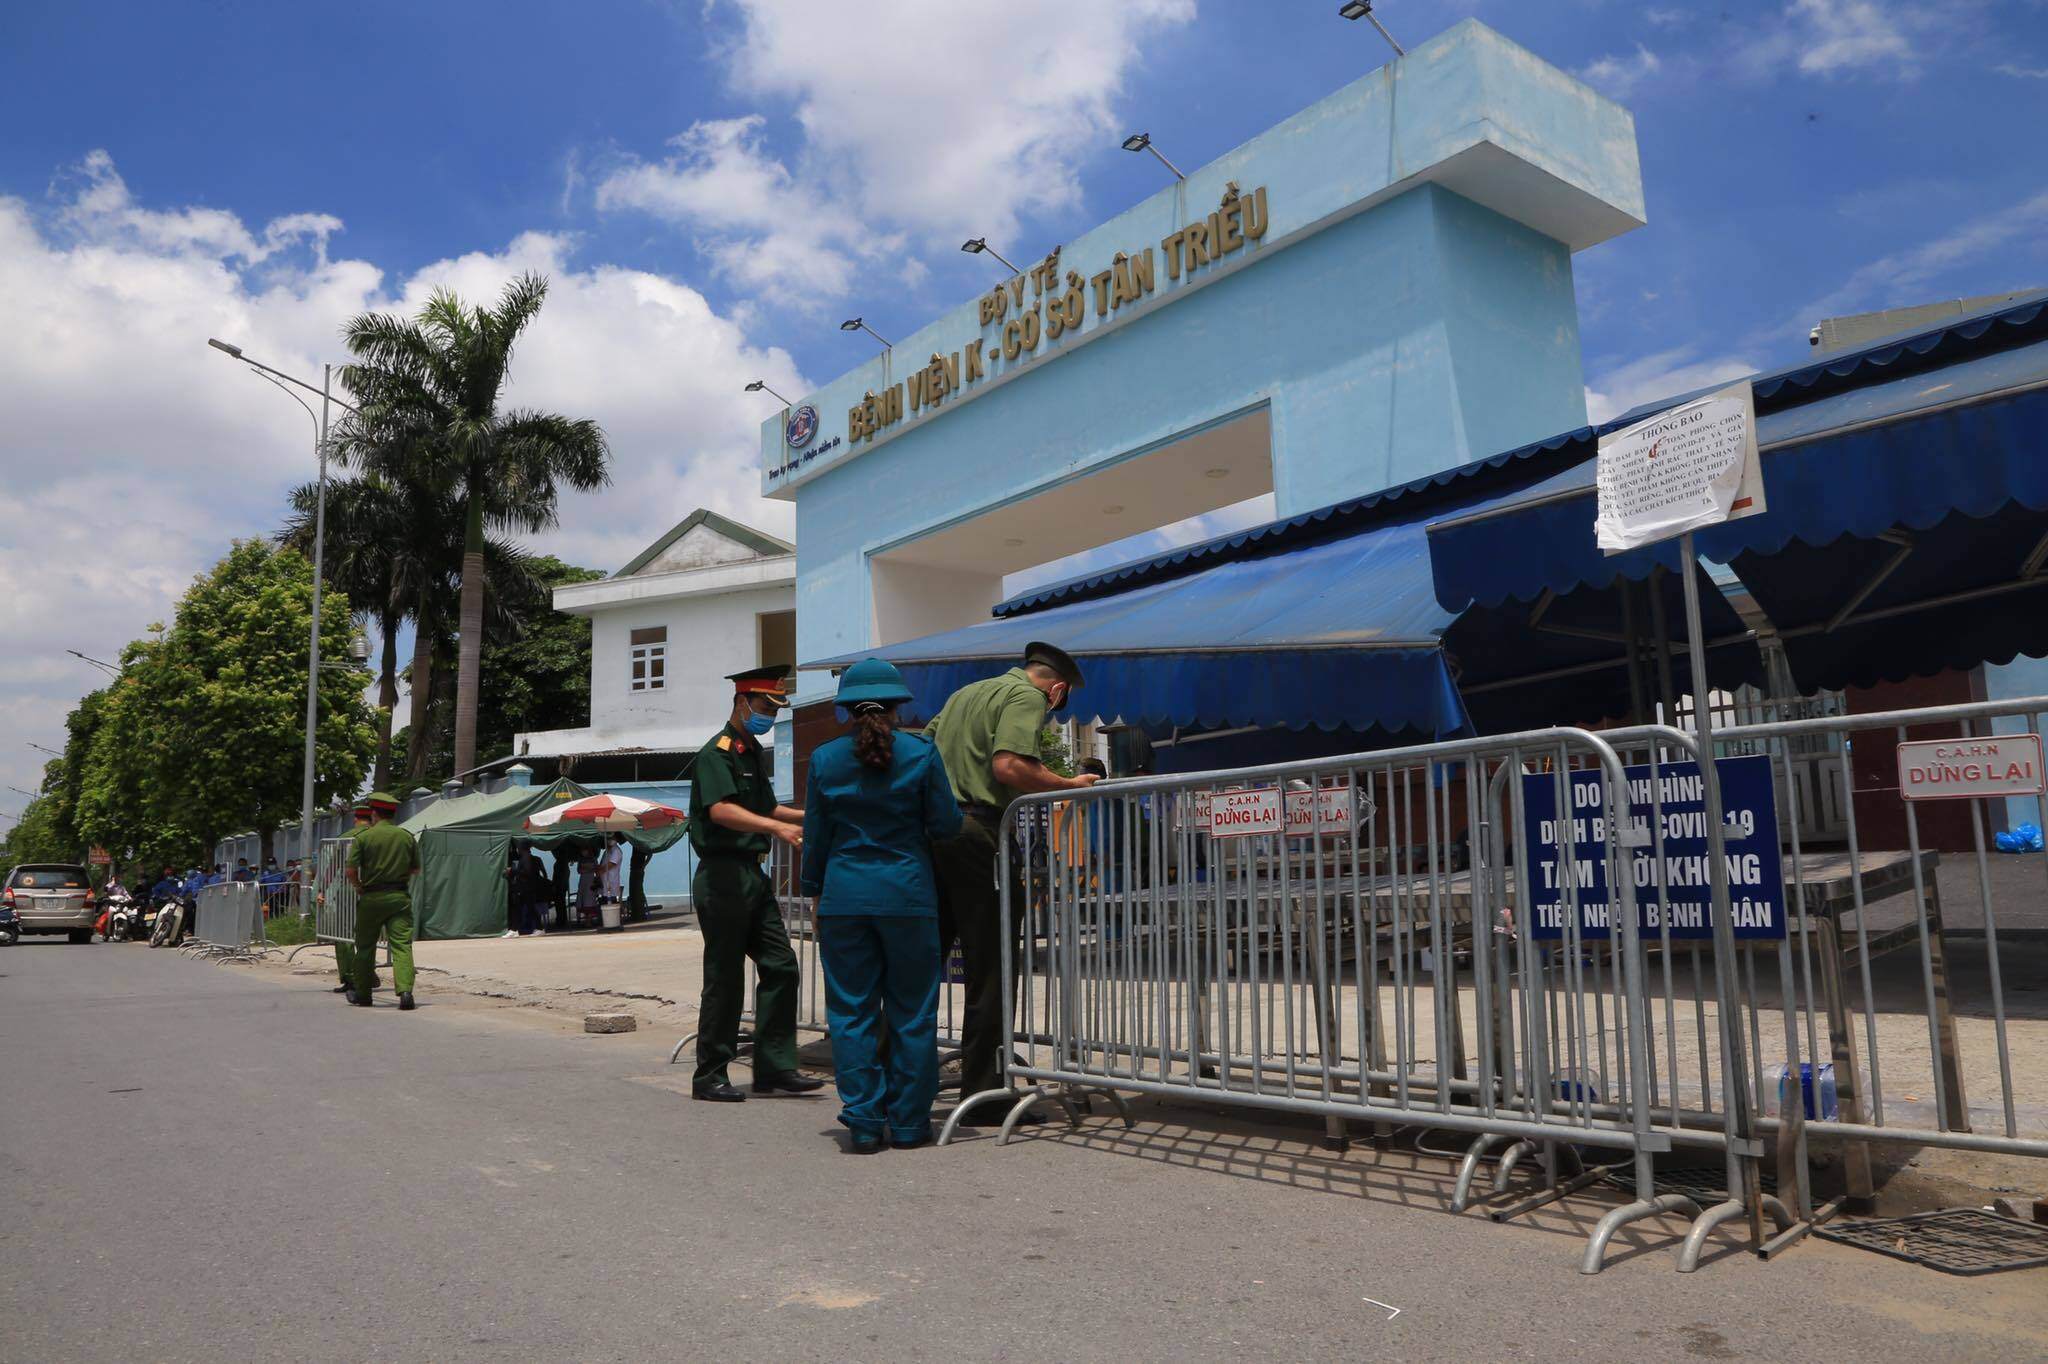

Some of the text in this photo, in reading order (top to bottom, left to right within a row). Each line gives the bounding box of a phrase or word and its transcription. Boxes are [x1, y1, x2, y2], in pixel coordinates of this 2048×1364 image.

[979, 245, 1061, 327] BỘ Y TẾ
[849, 387, 903, 443] BỆNH
[907, 353, 960, 408] VIỆN
[965, 338, 984, 382] K
[1003, 300, 1041, 360] CƠ
[1046, 270, 1085, 340] SỞ
[1092, 252, 1154, 316] TÂN
[1162, 180, 1268, 280] TRIỀU
[1642, 411, 1703, 440] THÔNG BÁO
[1936, 744, 1999, 758] C.A.H.N
[1909, 761, 2033, 784] DỪNG LẠI
[1228, 795, 1260, 806] C.A.H.N
[1574, 782, 1600, 808] DO
[1215, 807, 1276, 825] DỪNG LẠI
